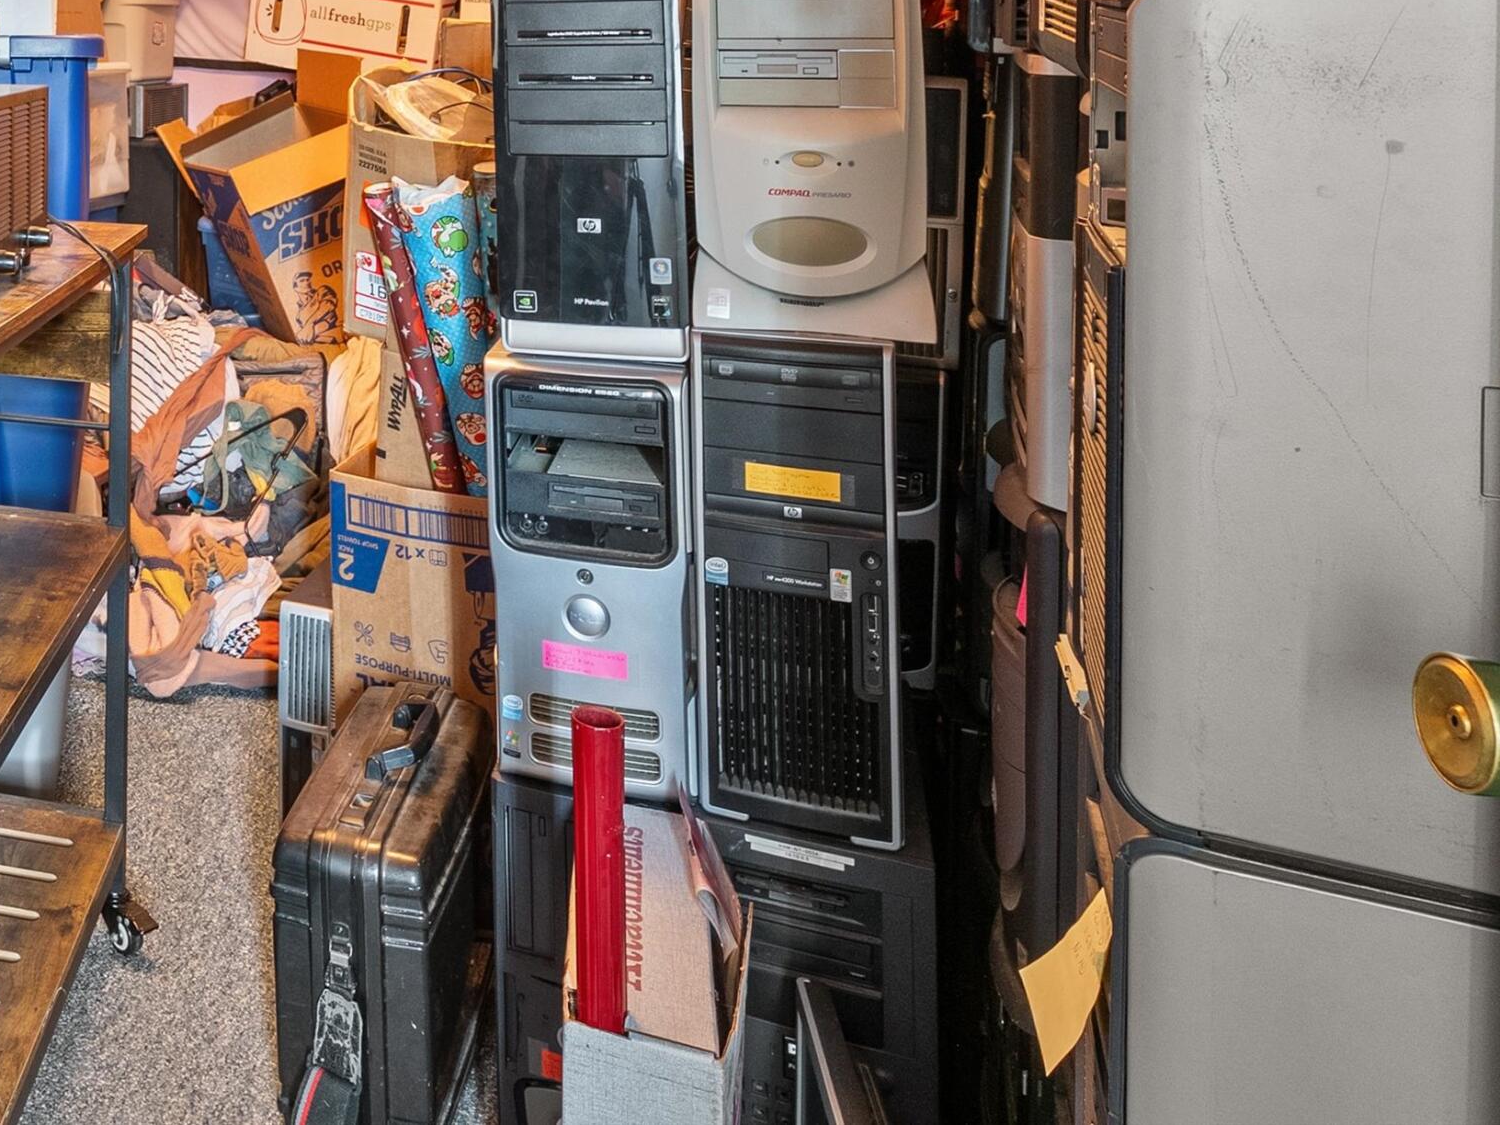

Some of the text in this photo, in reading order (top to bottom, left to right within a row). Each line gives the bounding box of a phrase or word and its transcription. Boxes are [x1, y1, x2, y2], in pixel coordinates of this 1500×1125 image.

[768, 188, 810, 197] COMPAQ
[573, 297, 609, 307] HP Pavilion
[538, 384, 592, 394] DIMENSION
[359, 539, 379, 550] SHOP
[395, 544, 413, 559] 12
[338, 552, 355, 581] 2
[355, 653, 452, 687] MULTI-PURPOSE
